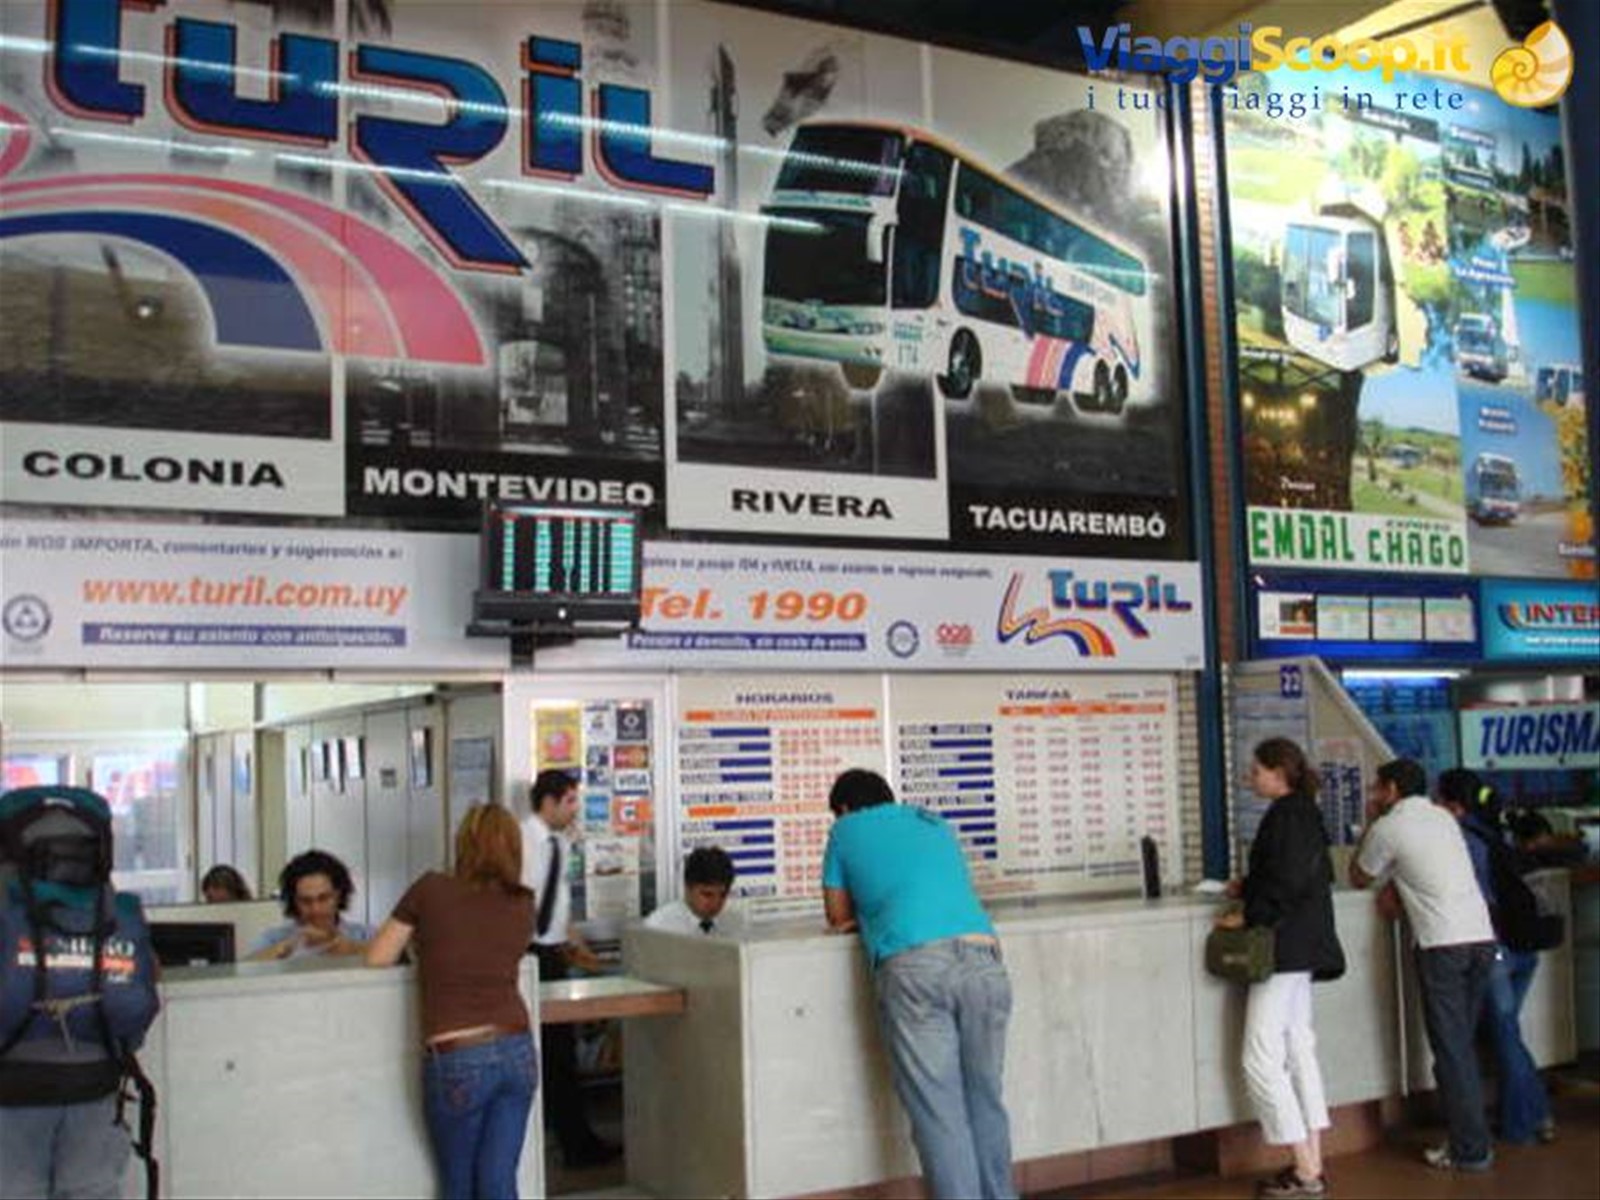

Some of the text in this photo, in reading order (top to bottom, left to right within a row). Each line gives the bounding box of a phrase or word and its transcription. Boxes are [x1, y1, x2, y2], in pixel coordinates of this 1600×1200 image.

[23, 450, 285, 488] COLONIA
[363, 466, 654, 507] MONTEVIDEO
[732, 489, 893, 520] RIVERA
[969, 504, 1167, 539] TACUAREMBÓ
[1251, 510, 1354, 562] EMDAL
[1368, 528, 1464, 567] CHAGO
[83, 576, 408, 616] www.turil.com.uy
[641, 587, 868, 622] Tel. 1990
